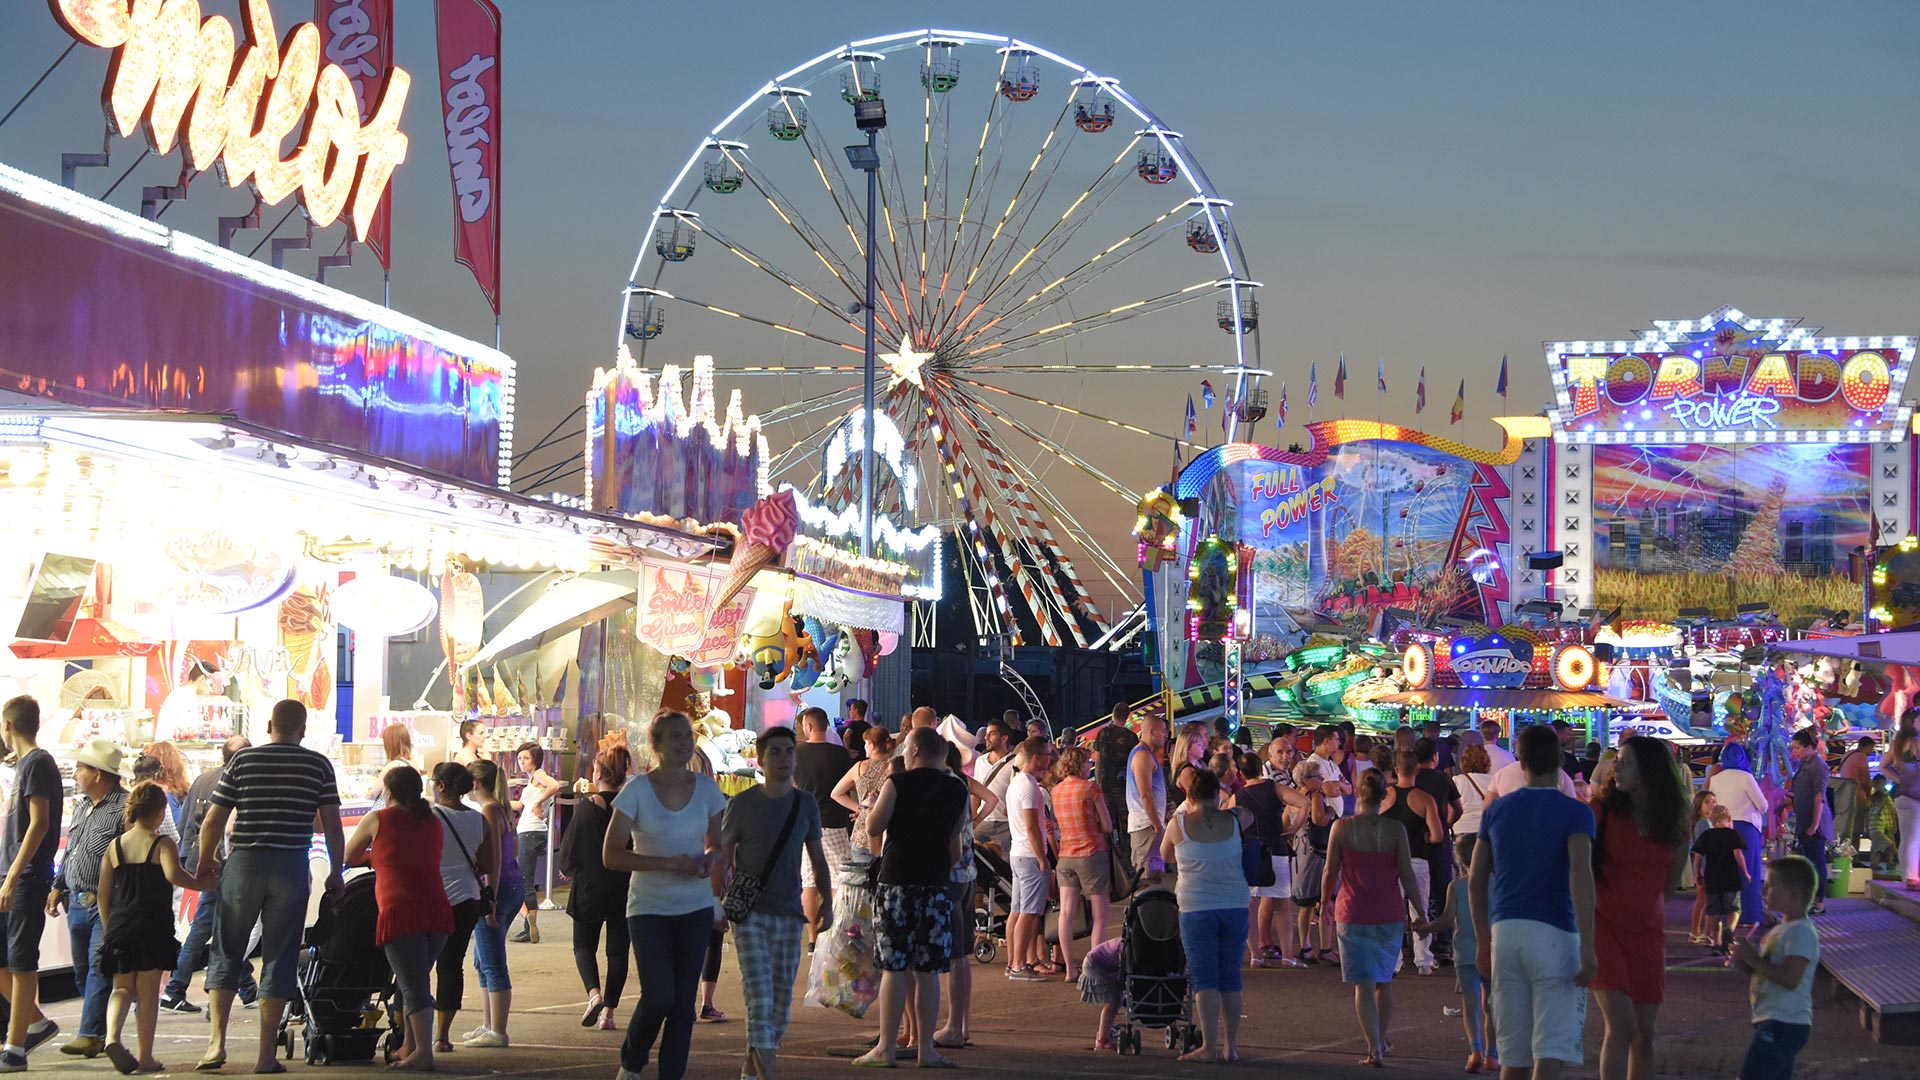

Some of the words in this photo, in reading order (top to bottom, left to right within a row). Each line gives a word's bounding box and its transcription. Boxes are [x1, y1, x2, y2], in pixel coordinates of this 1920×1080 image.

[1567, 351, 1891, 419] TORNADO
[1663, 396, 1780, 429] POWER
[1252, 467, 1299, 501] FULL
[1260, 476, 1338, 538] POWER
[640, 617, 698, 646] Glace
[1450, 656, 1532, 674] TORNADO
